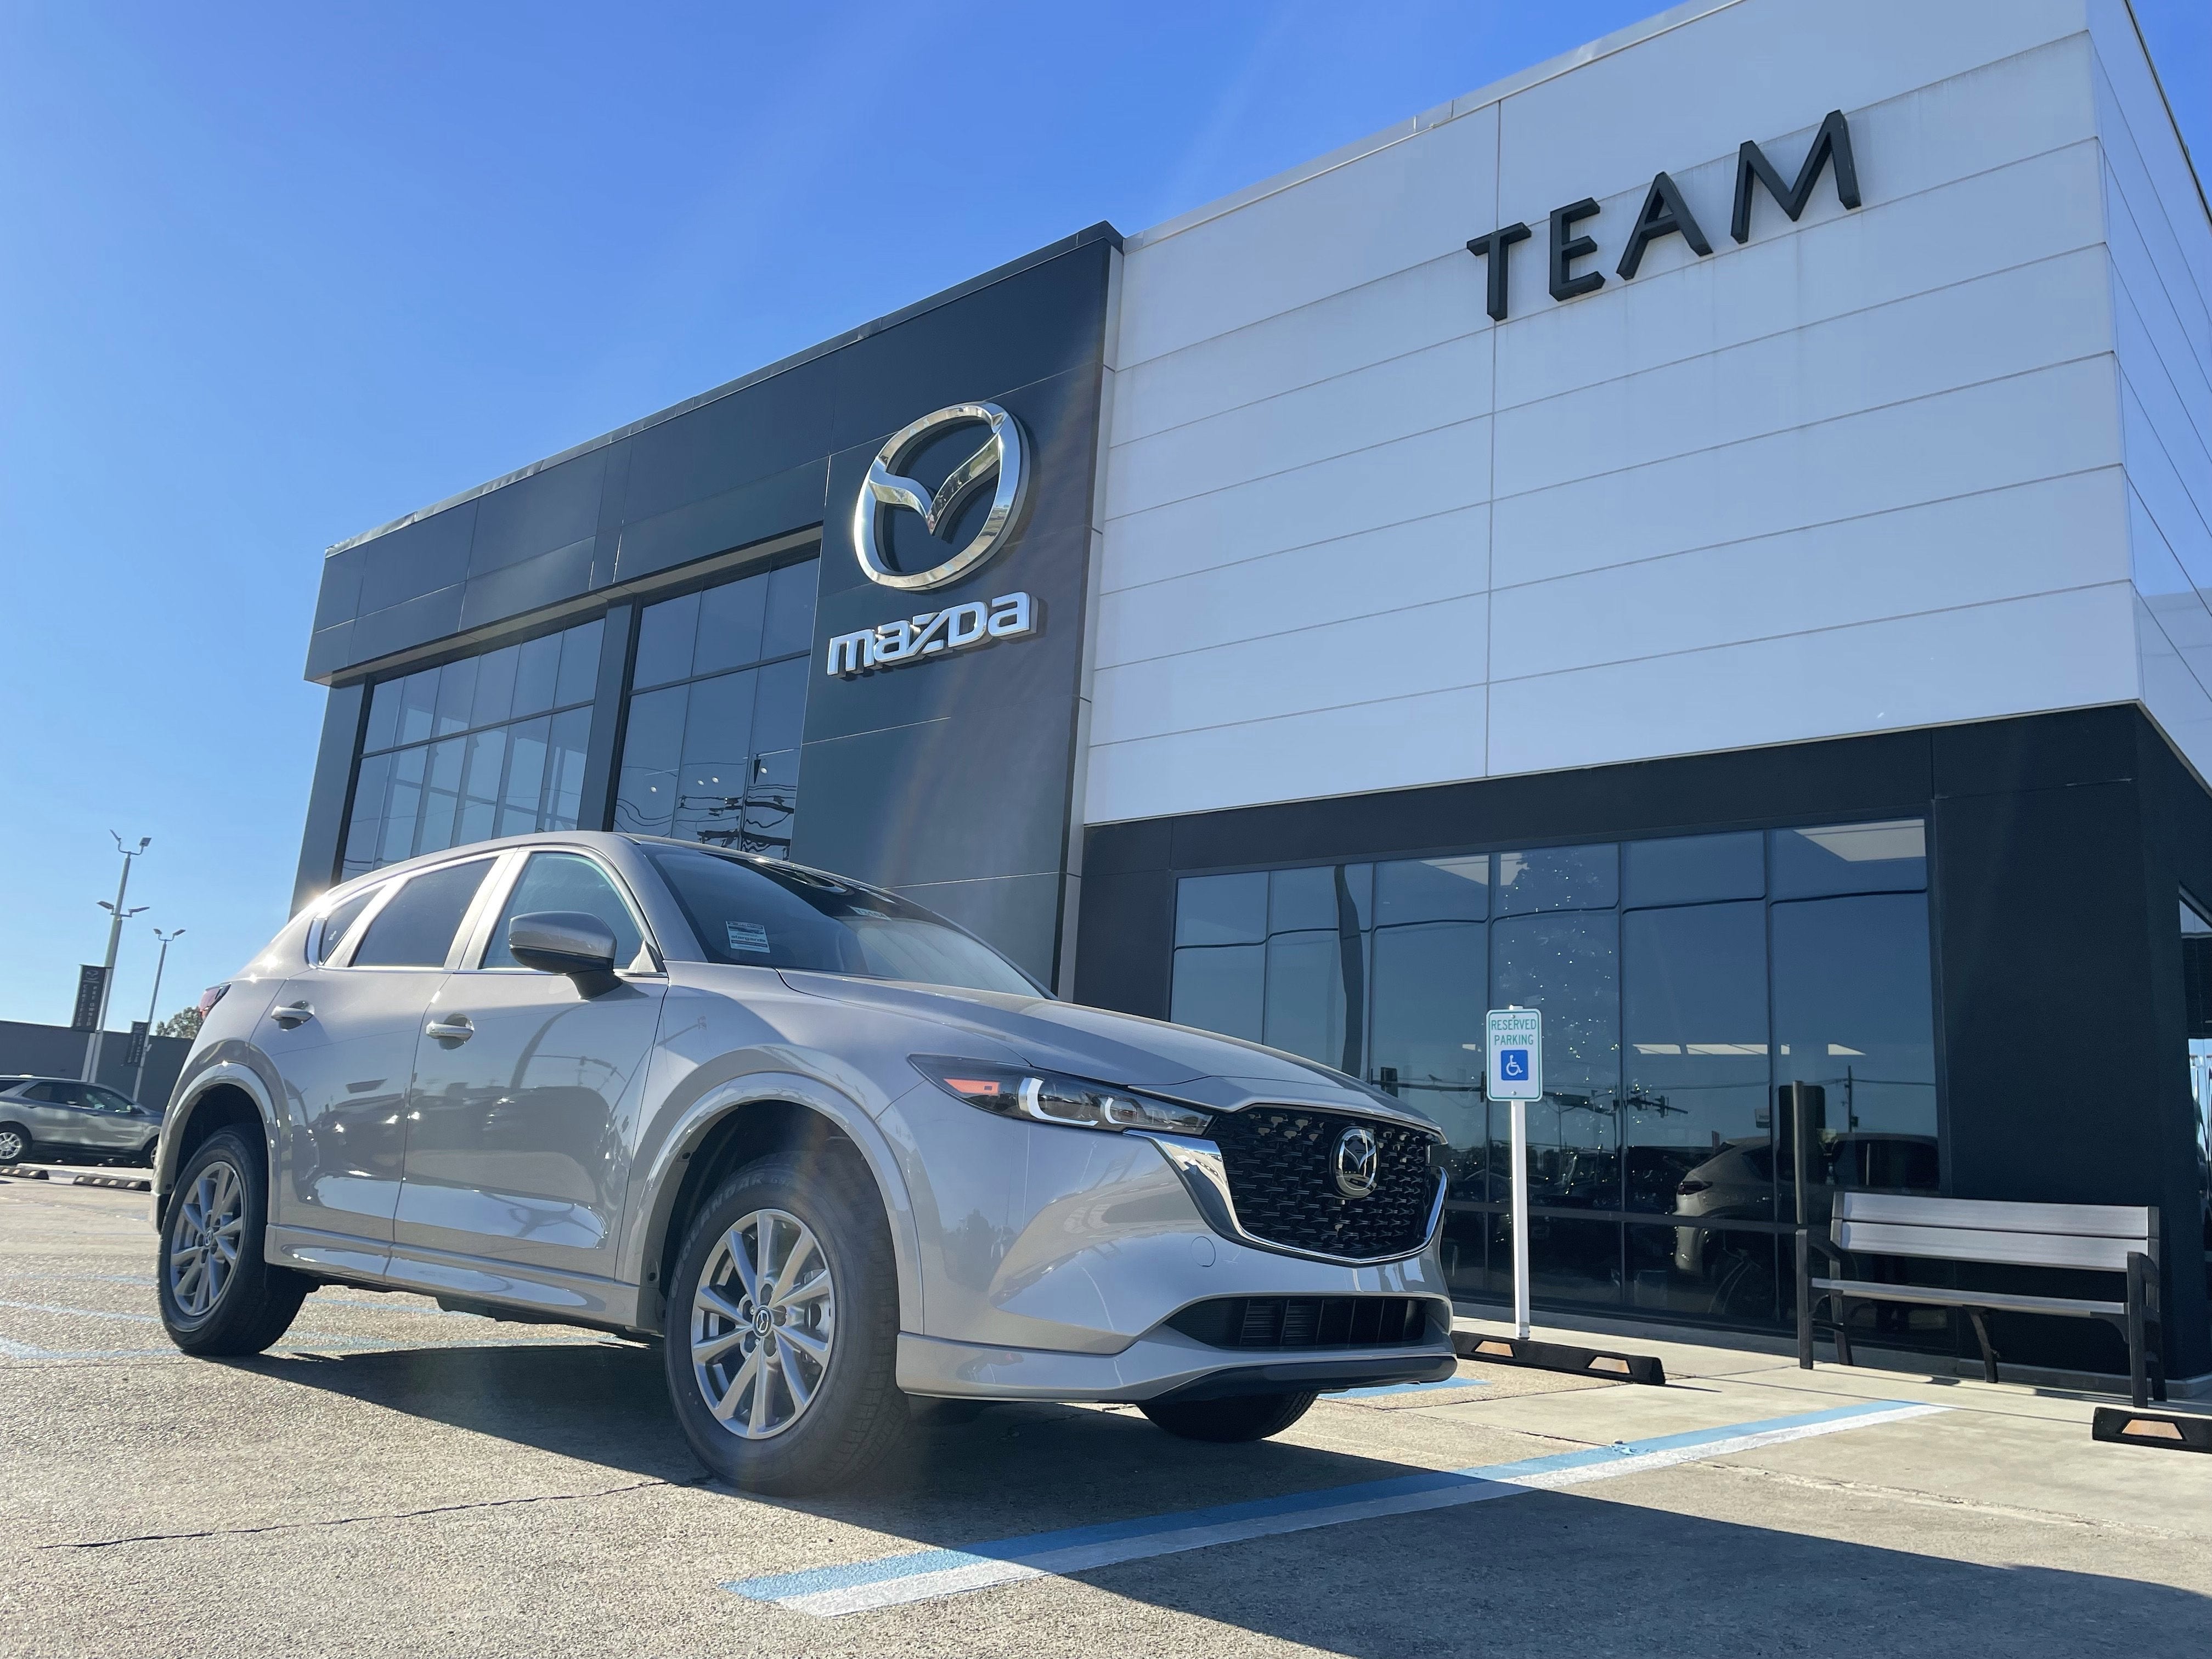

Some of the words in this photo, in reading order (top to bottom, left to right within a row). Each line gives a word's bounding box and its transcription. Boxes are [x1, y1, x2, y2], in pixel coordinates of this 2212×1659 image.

[1466, 109, 1862, 321] TEAM
[1491, 1019, 1536, 1030] RESERVED
[1494, 1034, 1534, 1046] PARKING
